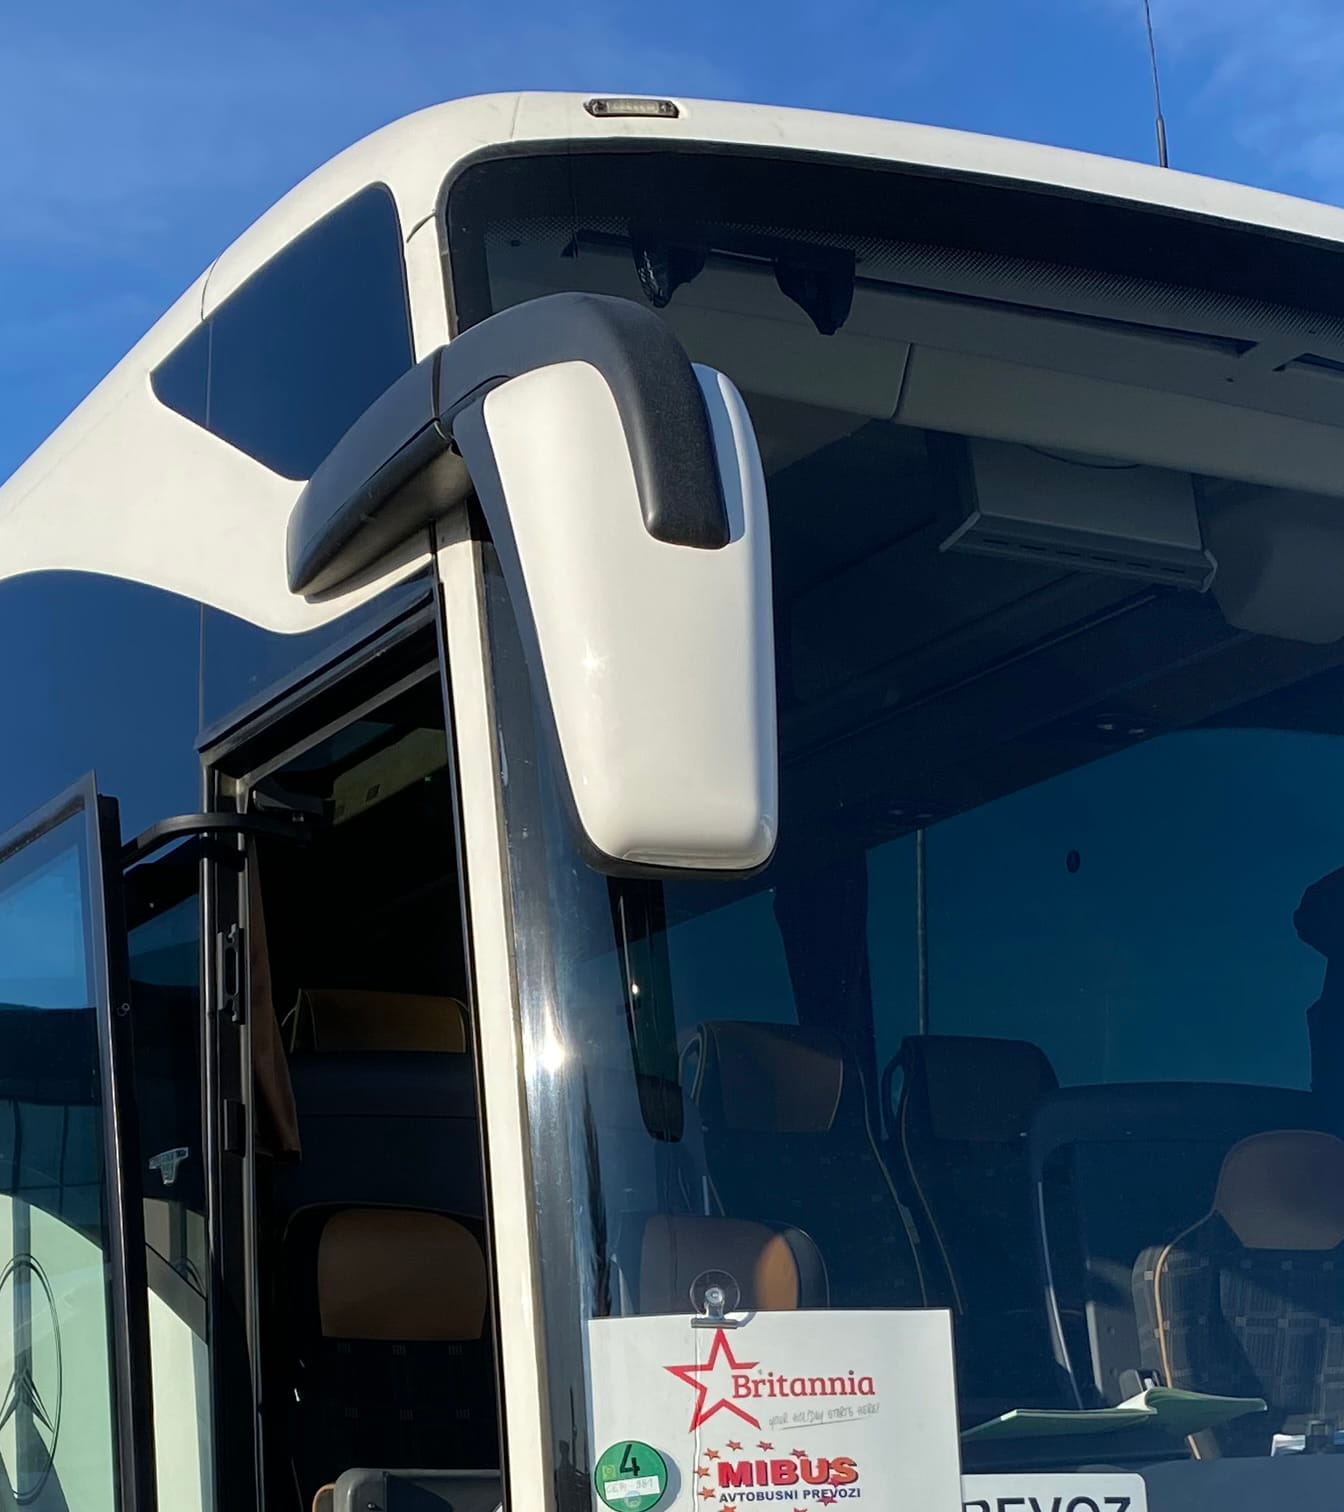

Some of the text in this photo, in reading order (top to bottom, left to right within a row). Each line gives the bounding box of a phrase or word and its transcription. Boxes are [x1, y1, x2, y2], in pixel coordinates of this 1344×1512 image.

[732, 1369, 876, 1399] Britannia
[620, 1443, 641, 1477] 4
[717, 1456, 860, 1488] MIBUS
[719, 1488, 861, 1503] AVTOBUSNI PREVOZI
